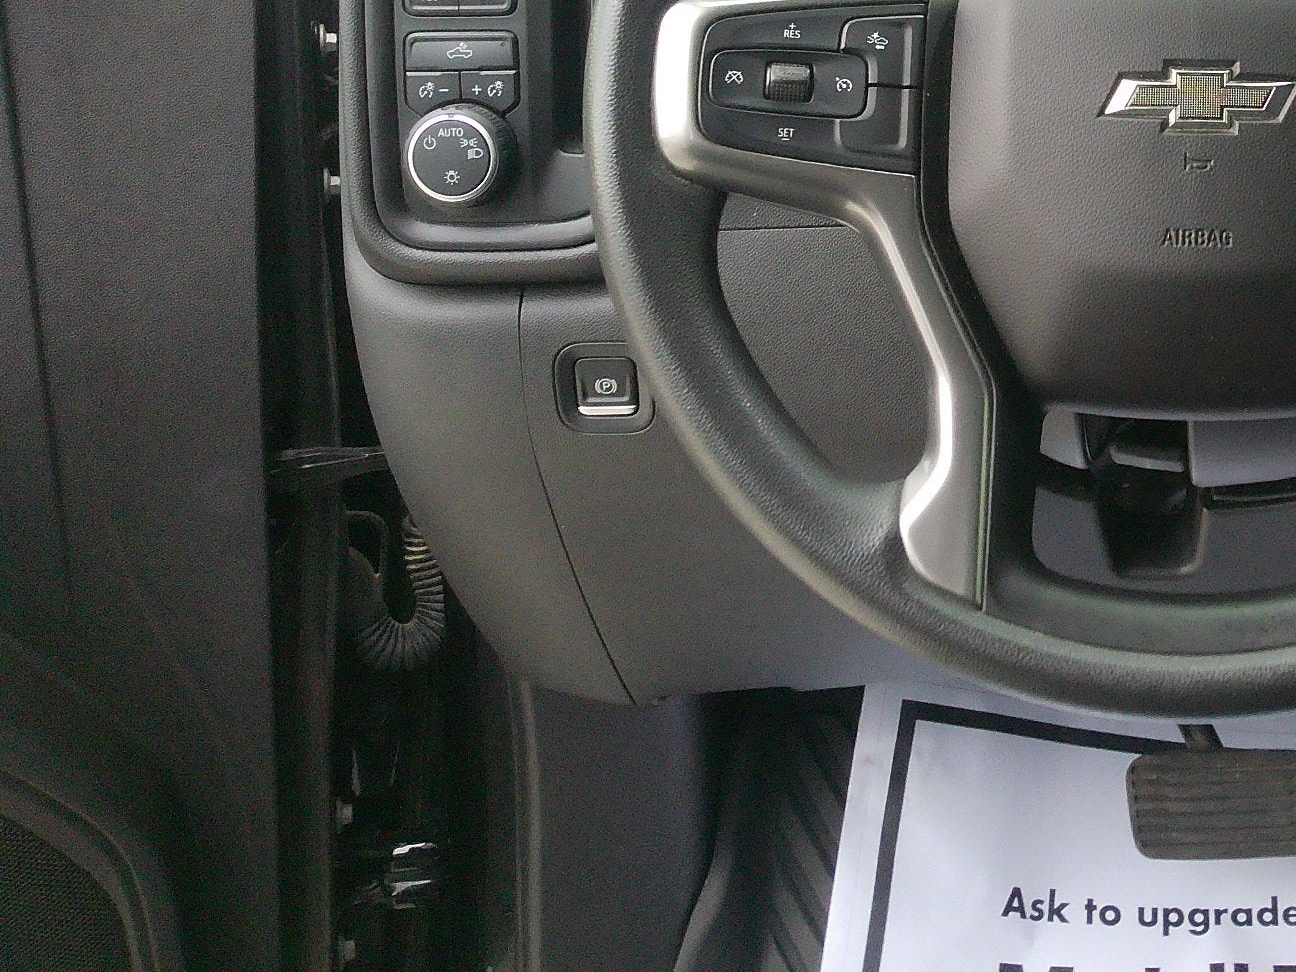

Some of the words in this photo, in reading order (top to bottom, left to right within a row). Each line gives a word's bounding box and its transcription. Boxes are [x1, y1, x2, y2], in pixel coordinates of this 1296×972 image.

[783, 29, 801, 39] RES
[438, 127, 464, 138] AUTO
[777, 127, 795, 138] SET
[1161, 227, 1234, 248] AIRBAG
[1000, 886, 1070, 924] Ask
[1085, 896, 1122, 926] to
